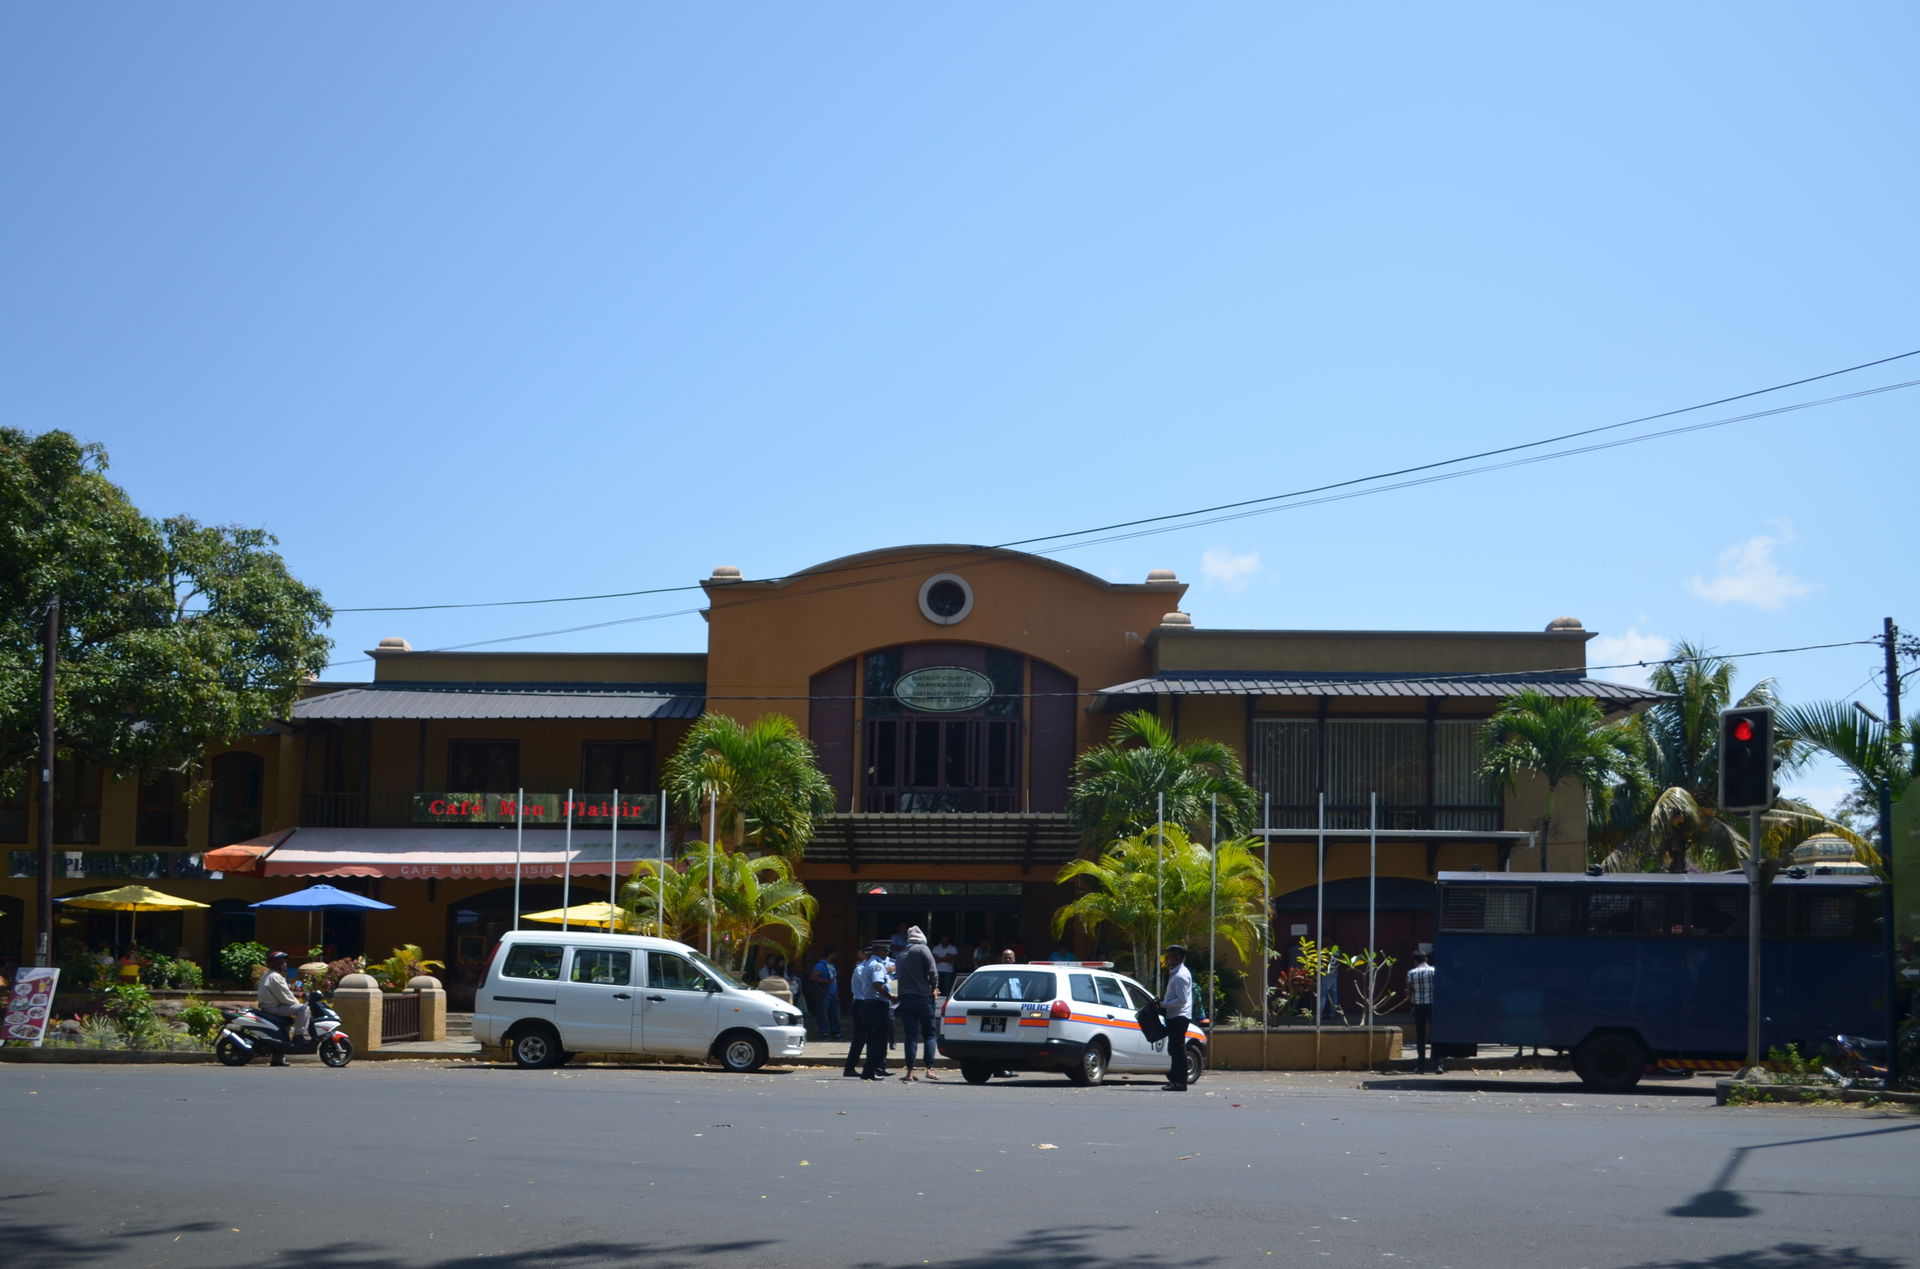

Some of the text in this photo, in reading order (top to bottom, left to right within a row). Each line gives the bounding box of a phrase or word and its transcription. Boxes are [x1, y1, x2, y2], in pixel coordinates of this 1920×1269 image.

[430, 799, 642, 817] Café Mon Plaisir
[400, 865, 440, 875] CAFE
[451, 865, 483, 875] MON
[1021, 1003, 1052, 1012] POLICE
